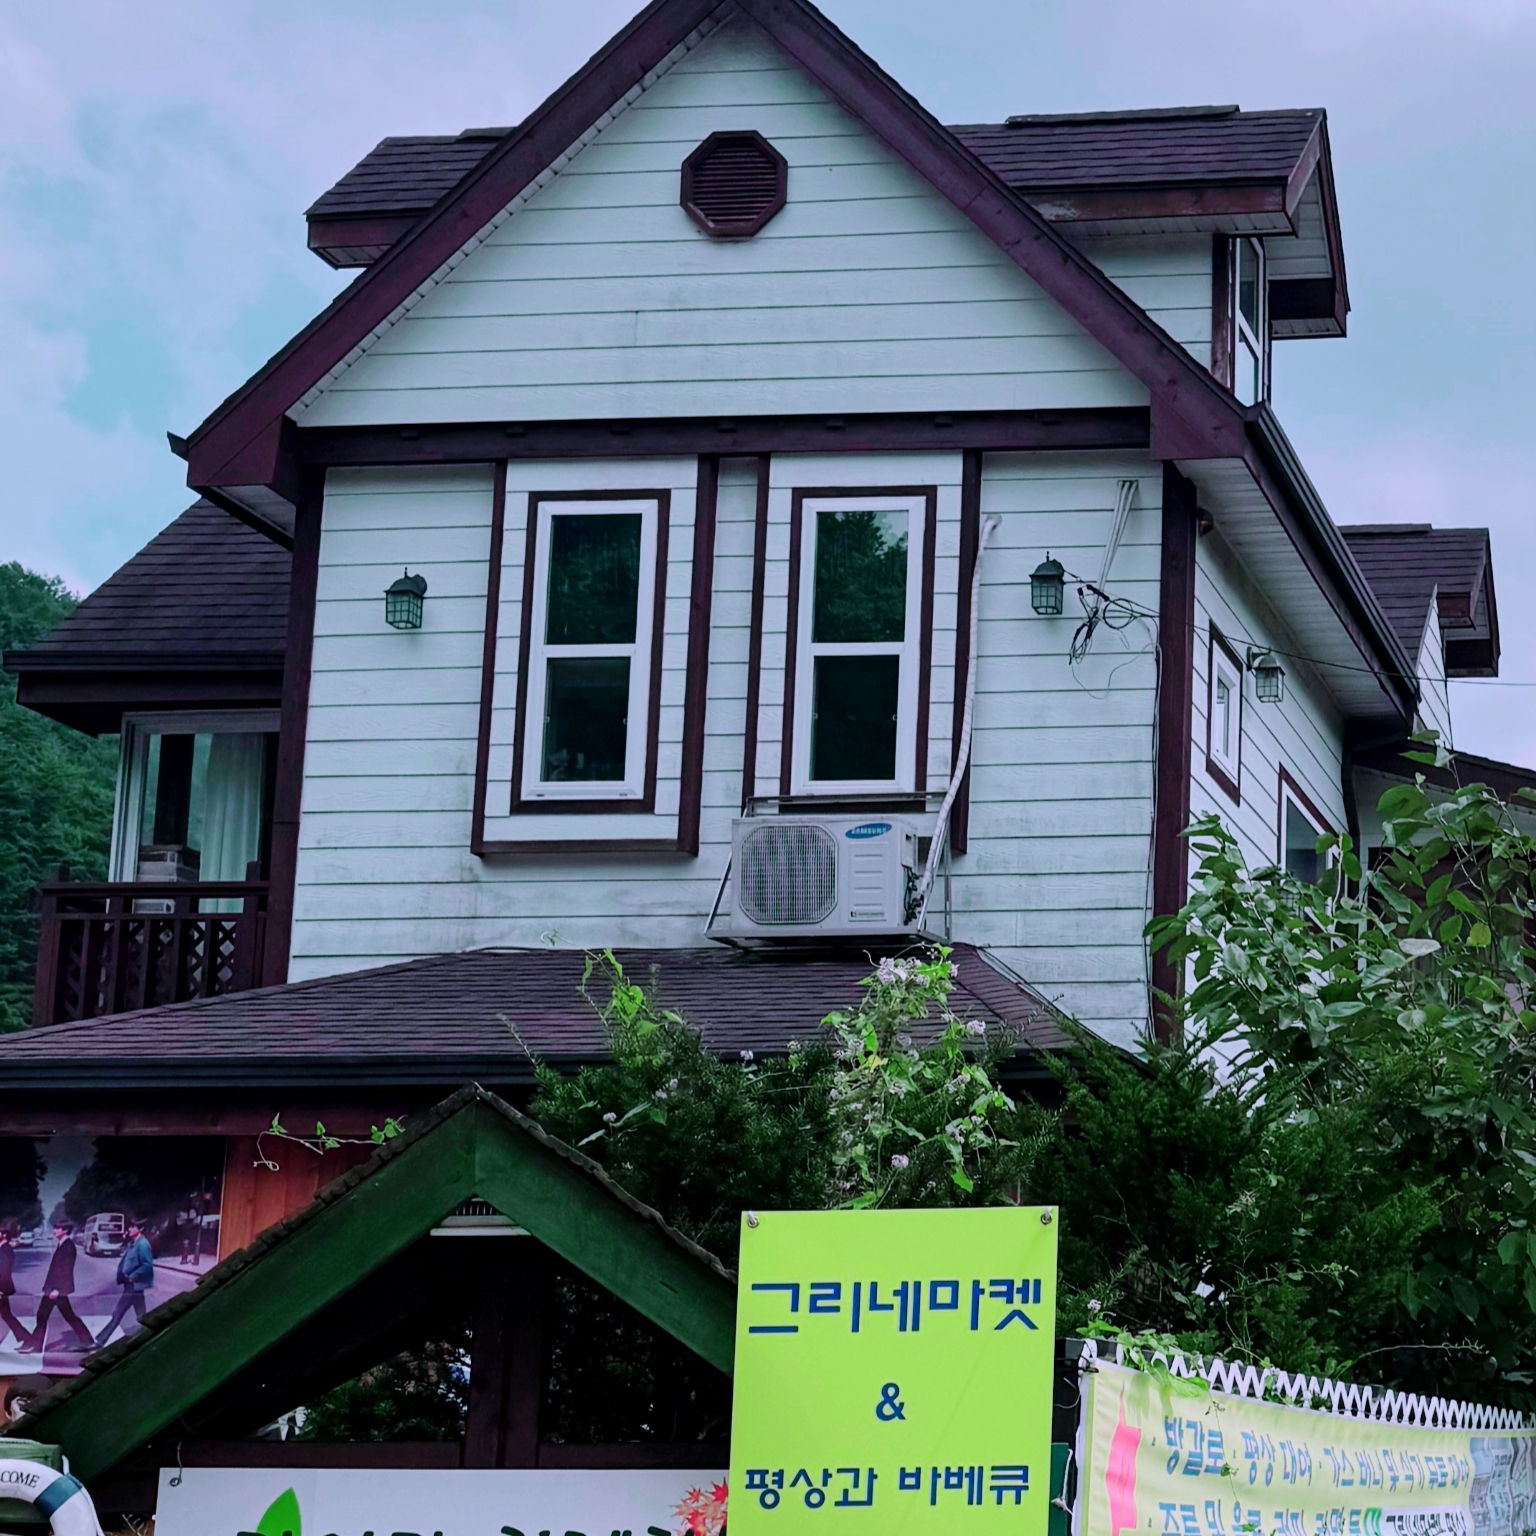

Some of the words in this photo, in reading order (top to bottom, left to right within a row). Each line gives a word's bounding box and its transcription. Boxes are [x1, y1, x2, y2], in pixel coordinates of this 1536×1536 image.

[748, 1278, 1041, 1333] 그리네마켓
[875, 1382, 906, 1421] &
[1164, 1416, 1224, 1477] 방갈로
[0, 1470, 40, 1488] COME
[745, 1468, 877, 1510] 평상과
[899, 1465, 1029, 1506] 바베큐
